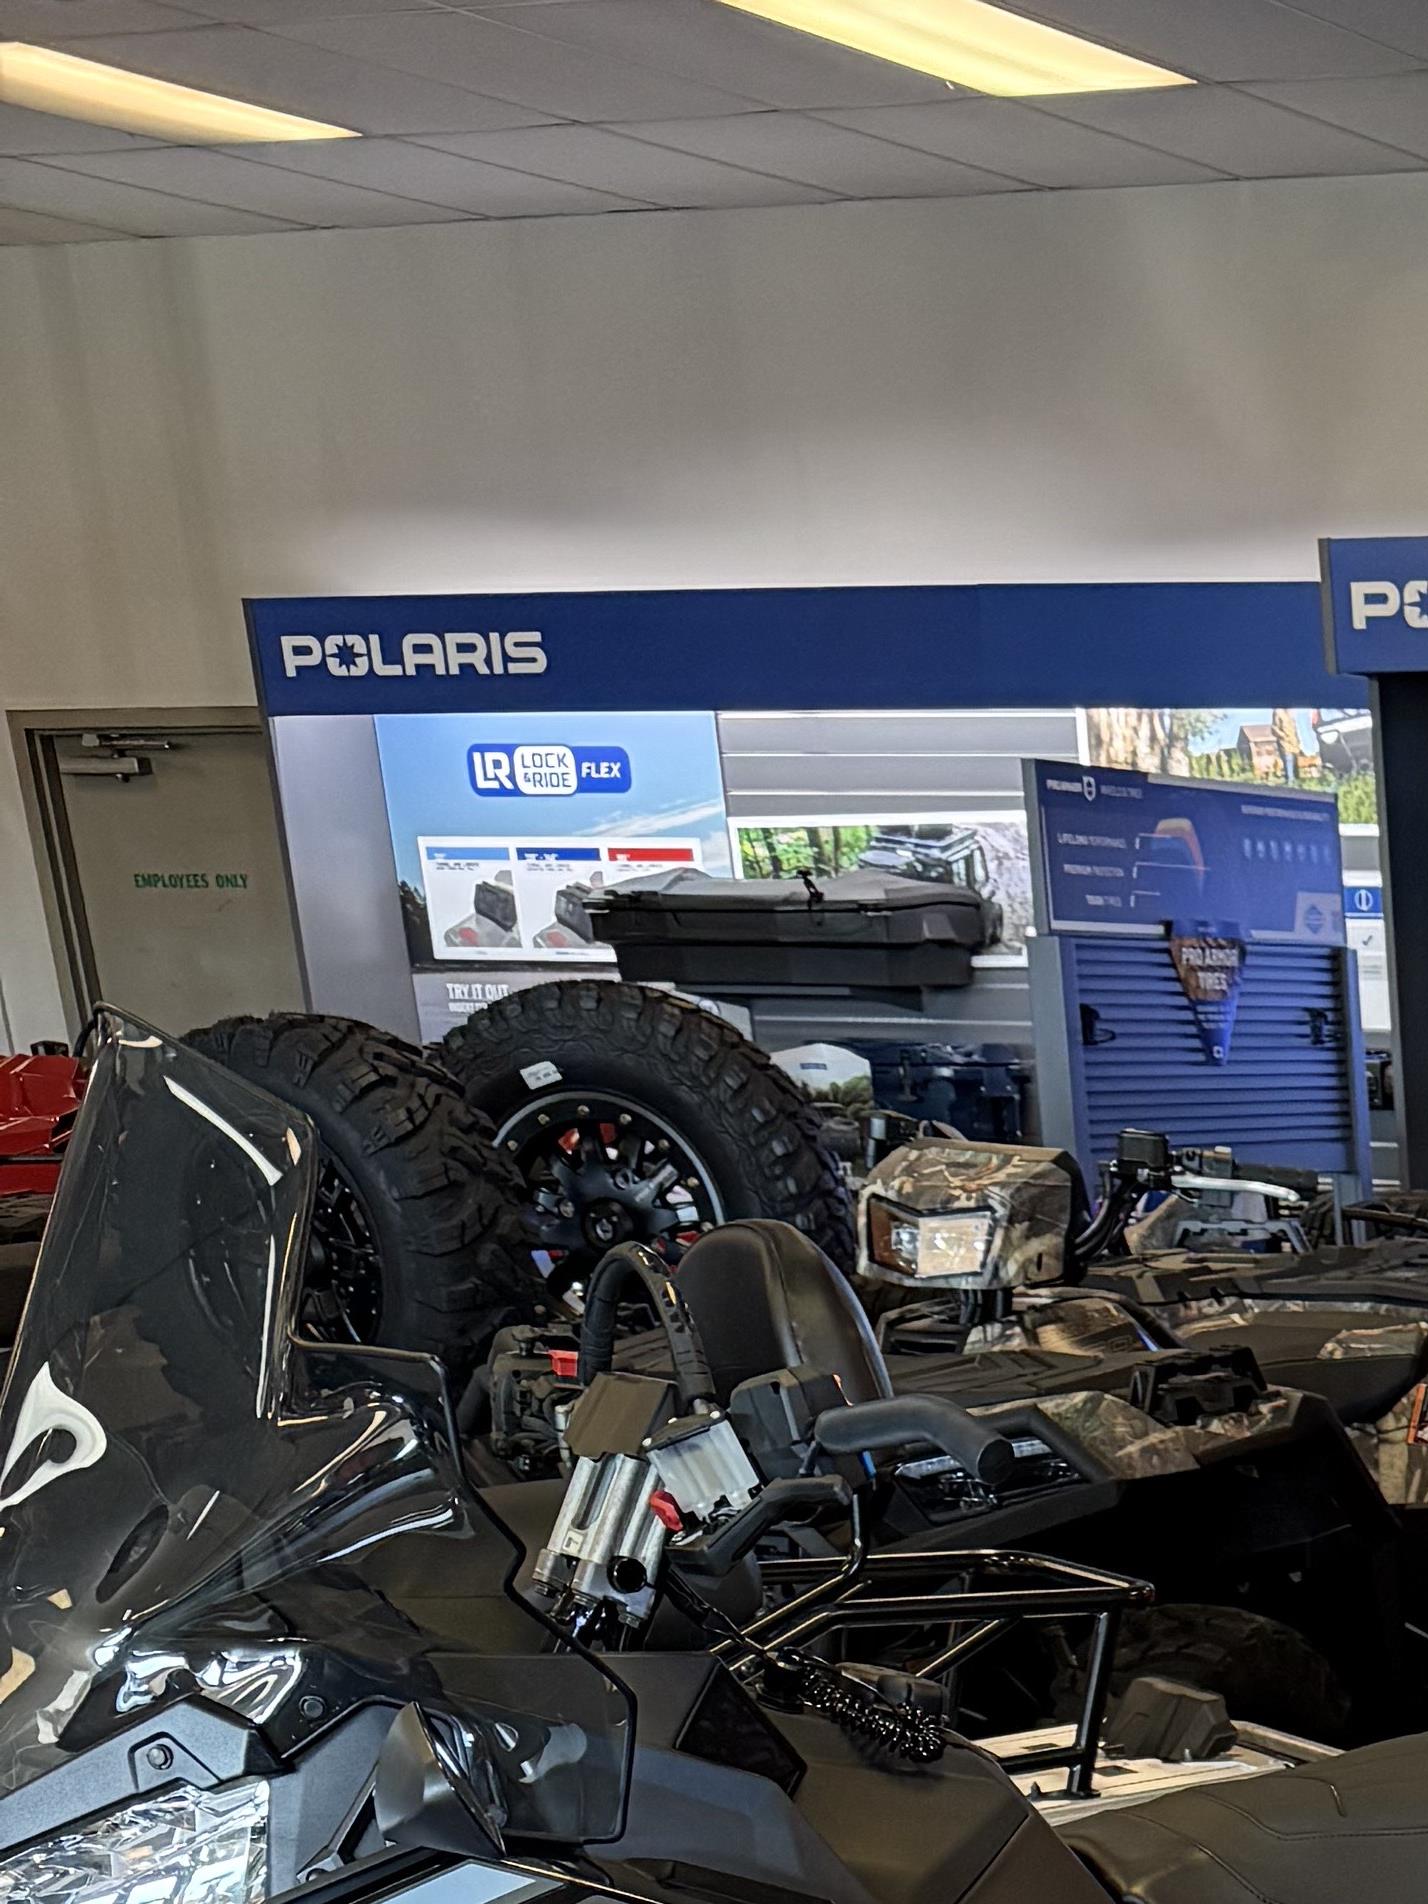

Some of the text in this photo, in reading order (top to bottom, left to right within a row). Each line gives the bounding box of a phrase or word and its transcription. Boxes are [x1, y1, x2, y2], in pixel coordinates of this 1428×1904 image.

[280, 631, 548, 677] POLARIS
[521, 752, 568, 769] LOCK
[472, 751, 515, 789] LR
[581, 761, 621, 779] FLEX
[133, 872, 249, 889] EMPLOYEES ONLY
